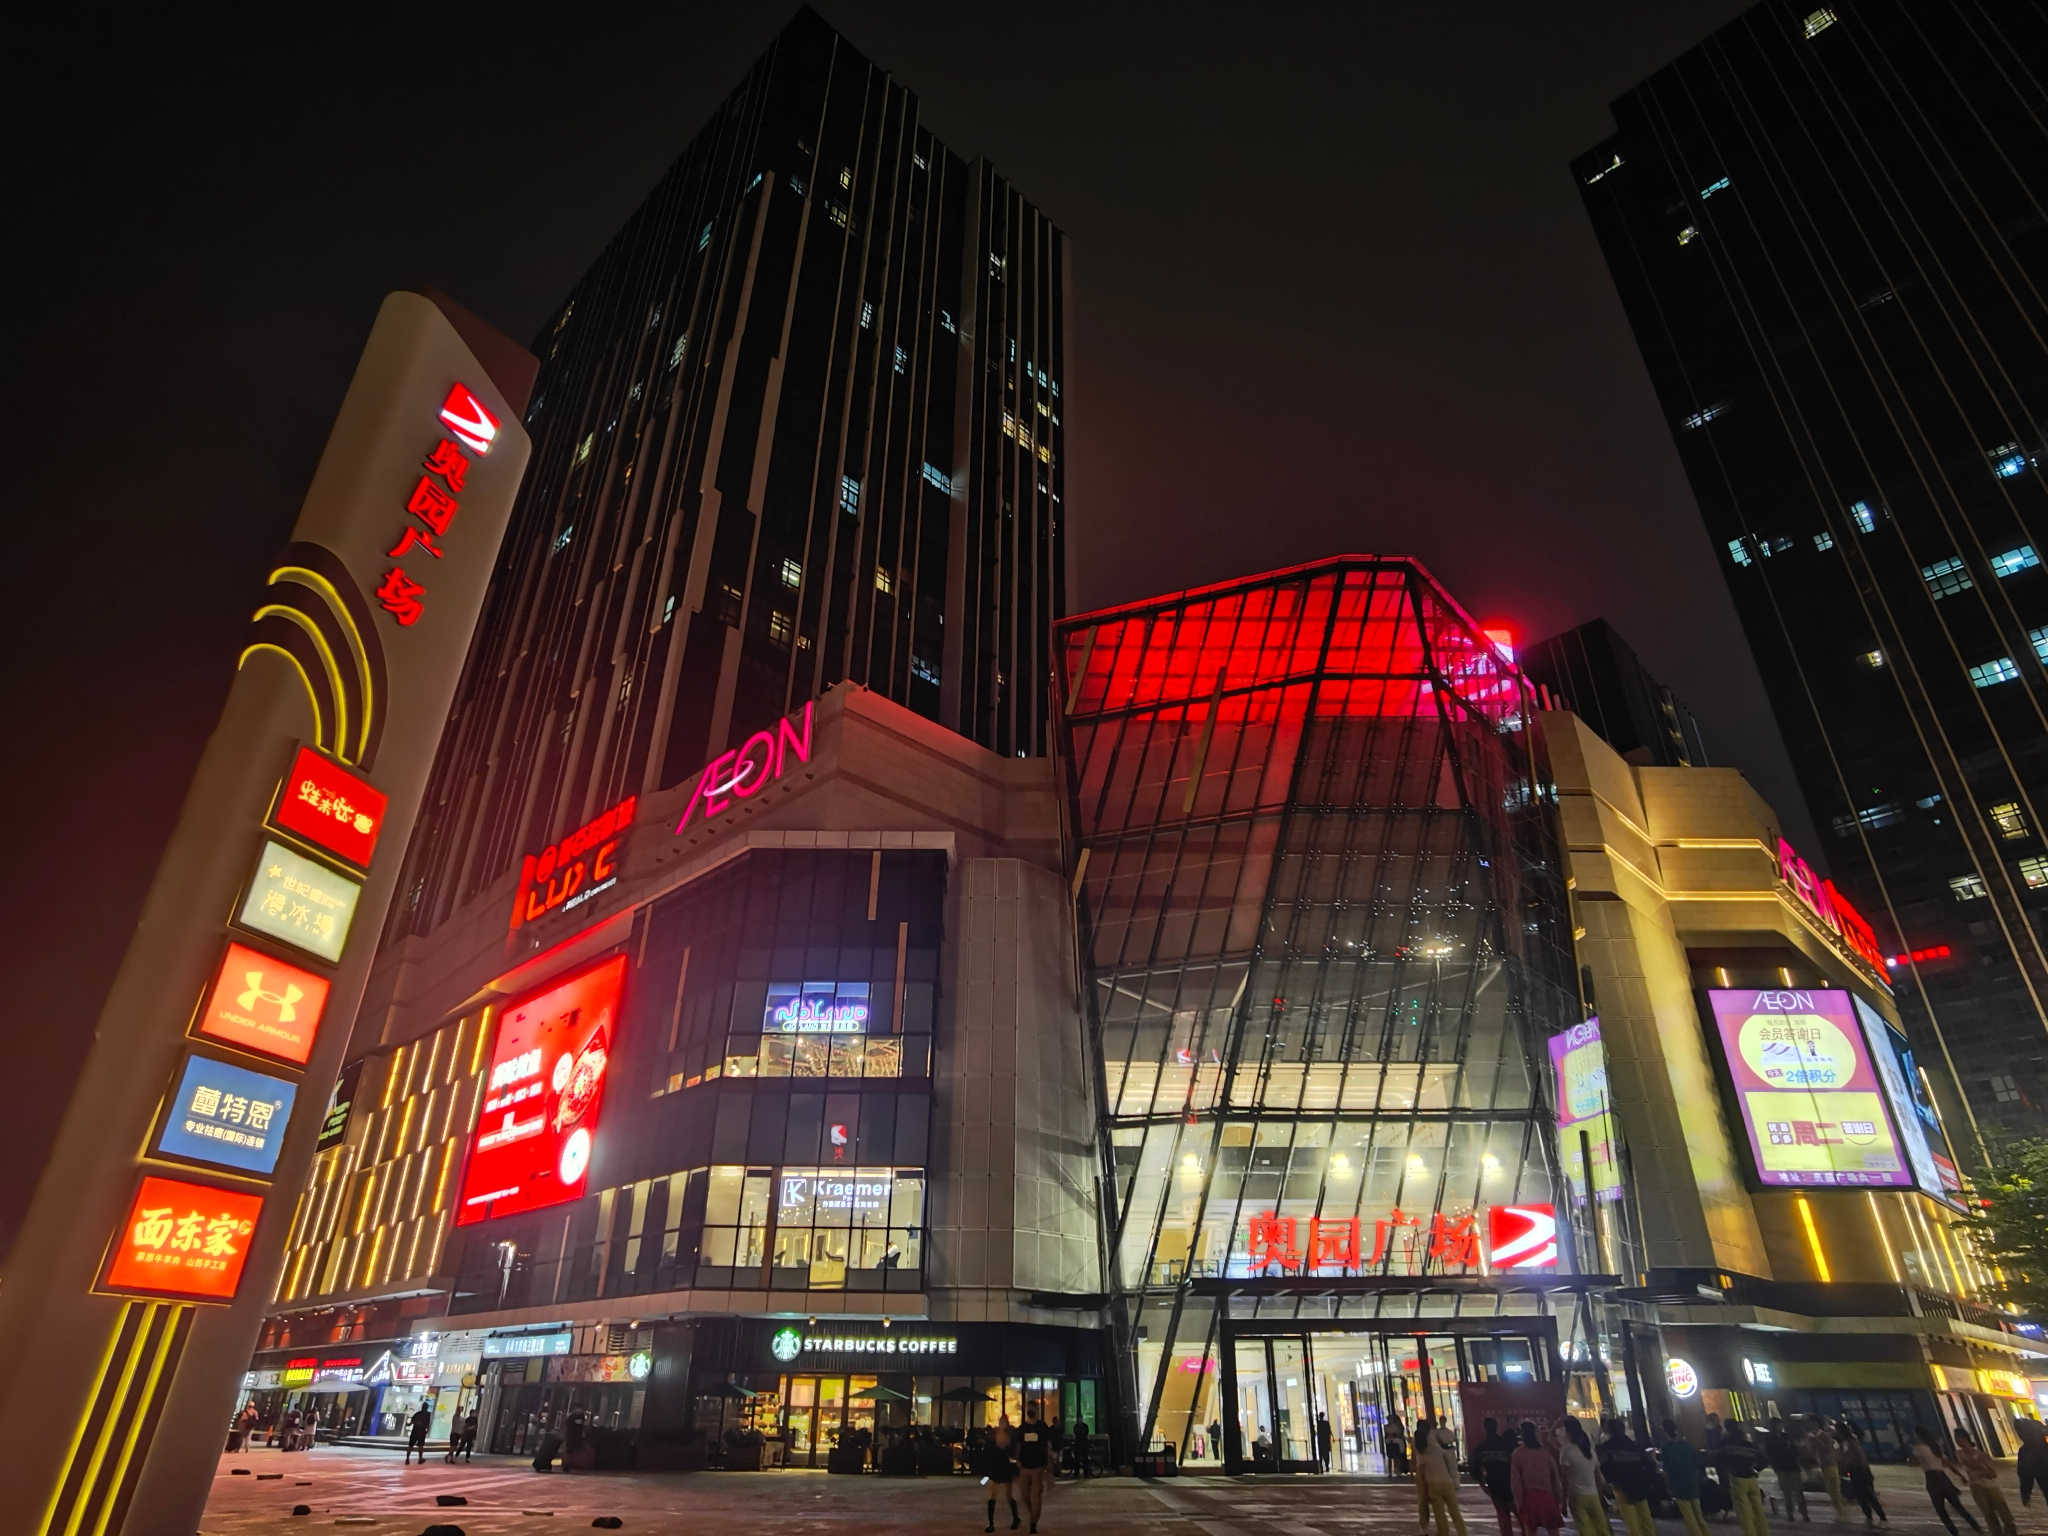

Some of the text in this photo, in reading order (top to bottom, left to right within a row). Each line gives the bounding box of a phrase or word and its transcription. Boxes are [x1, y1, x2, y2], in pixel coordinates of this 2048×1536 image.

[376, 438, 470, 627] 奥园广场
[262, 889, 335, 936] 滑冰場
[219, 1010, 301, 1045] UNDER ARMOUR
[1758, 1027, 1822, 1041] 会员答谢日
[1785, 1069, 1836, 1084] 2倍积分
[191, 1085, 275, 1131] 蕾特恩
[1791, 1120, 1844, 1146] 周二
[812, 1180, 892, 1196] Kraemer
[133, 1207, 240, 1257] 面东家
[1246, 1208, 1486, 1271] 奥园广场
[803, 1337, 958, 1355] STARBUCKS COFFEE
[1668, 1373, 1693, 1387] KING
